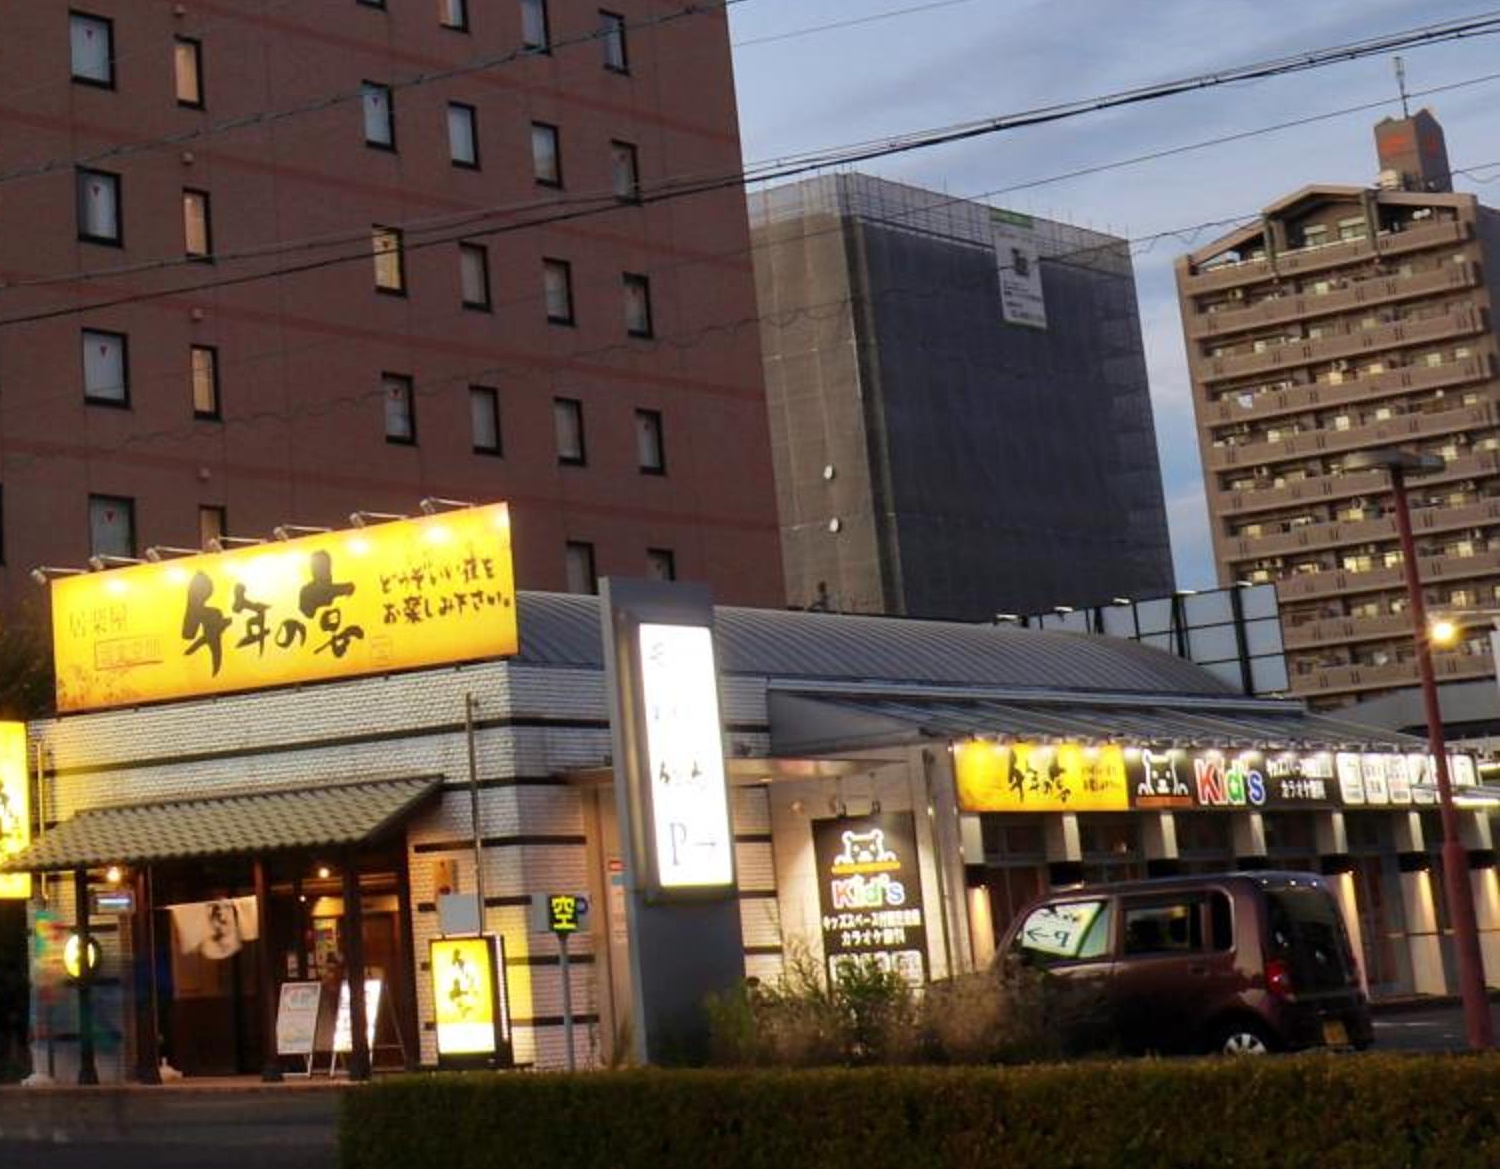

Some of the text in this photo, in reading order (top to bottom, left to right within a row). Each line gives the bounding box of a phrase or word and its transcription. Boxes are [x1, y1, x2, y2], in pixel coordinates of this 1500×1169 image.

[181, 549, 364, 678] 千年の宴
[669, 822, 686, 866] P
[551, 896, 577, 930] 空
